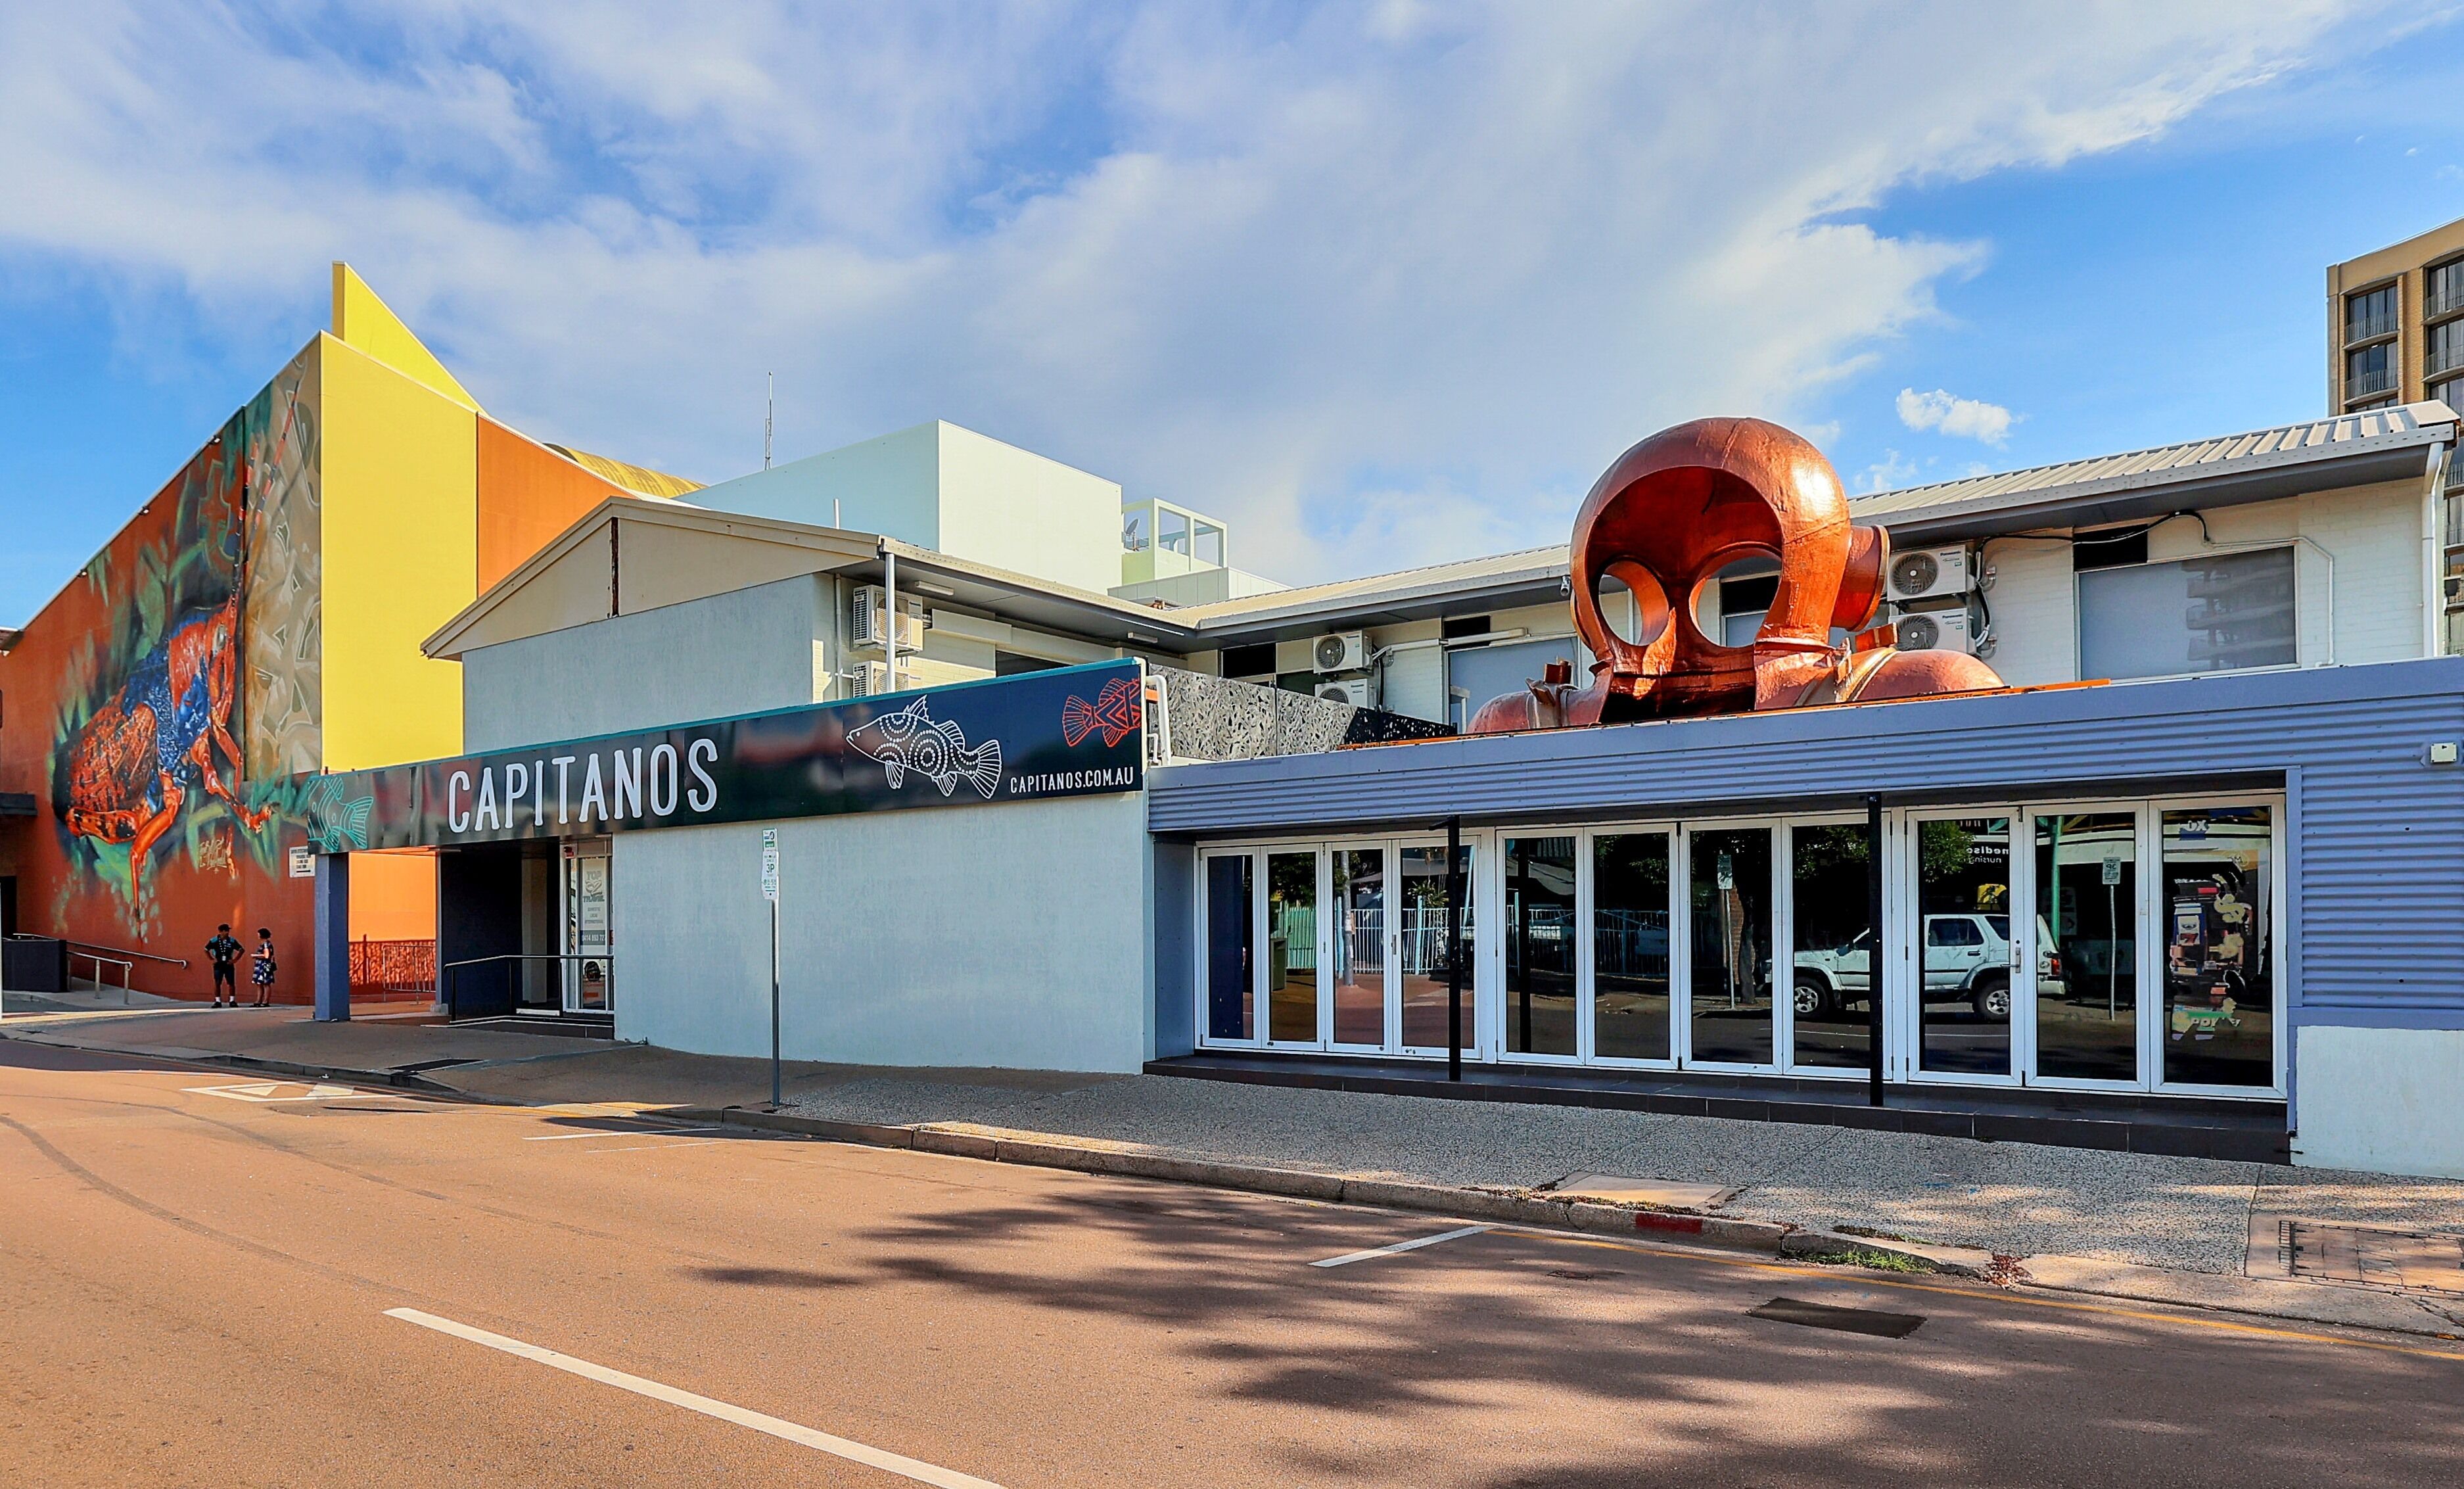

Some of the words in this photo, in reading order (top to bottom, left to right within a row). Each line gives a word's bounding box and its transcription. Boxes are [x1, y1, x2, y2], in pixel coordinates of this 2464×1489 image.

[448, 738, 718, 834] CAPITANOS
[1010, 766, 1134, 793] CAPITANOS.COM.AU
[766, 863, 775, 874] 3P
